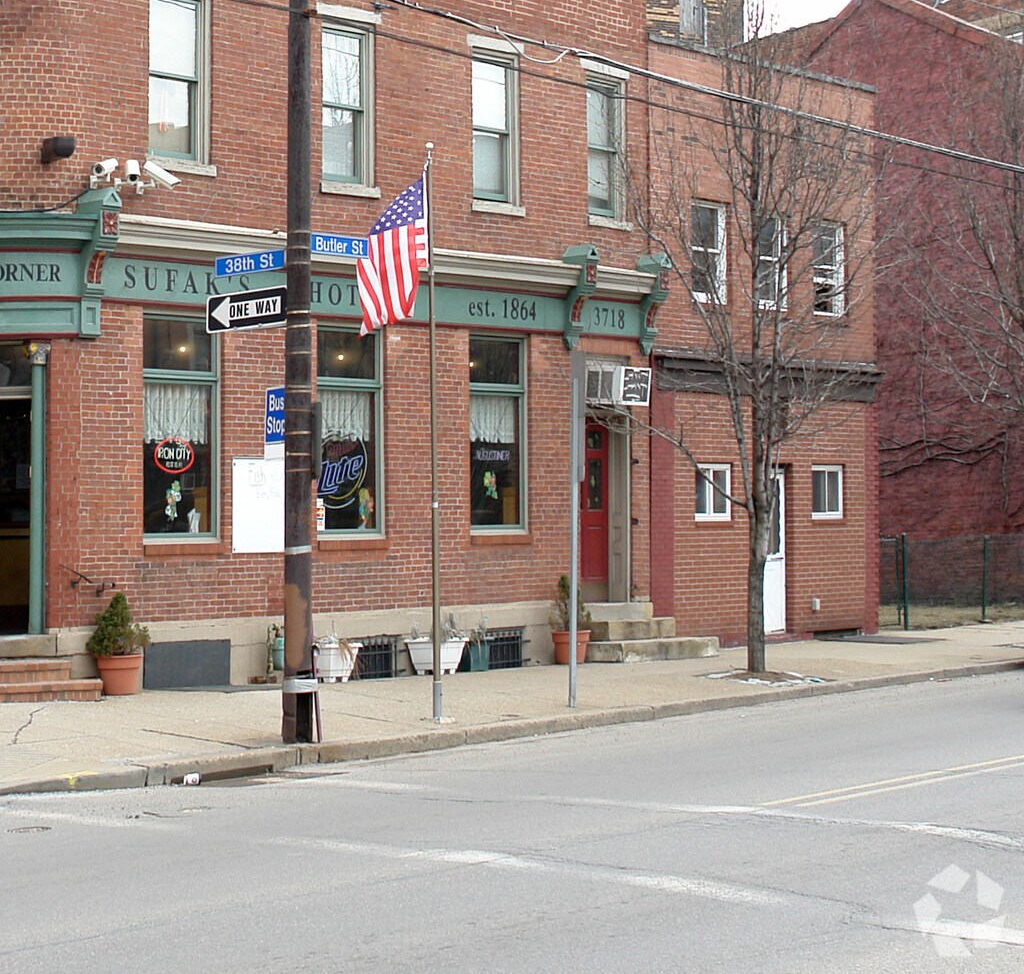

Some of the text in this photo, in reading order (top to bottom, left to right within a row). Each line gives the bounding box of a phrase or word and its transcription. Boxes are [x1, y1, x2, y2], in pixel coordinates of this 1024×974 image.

[315, 237, 364, 255] Butler St
[225, 253, 274, 274] 38th St
[310, 281, 359, 306] HOT
[229, 298, 278, 318] ONE WAY
[468, 297, 537, 321] est. 1864
[594, 306, 625, 330] 3718
[269, 393, 285, 412] Bus
[266, 415, 285, 436] Stop
